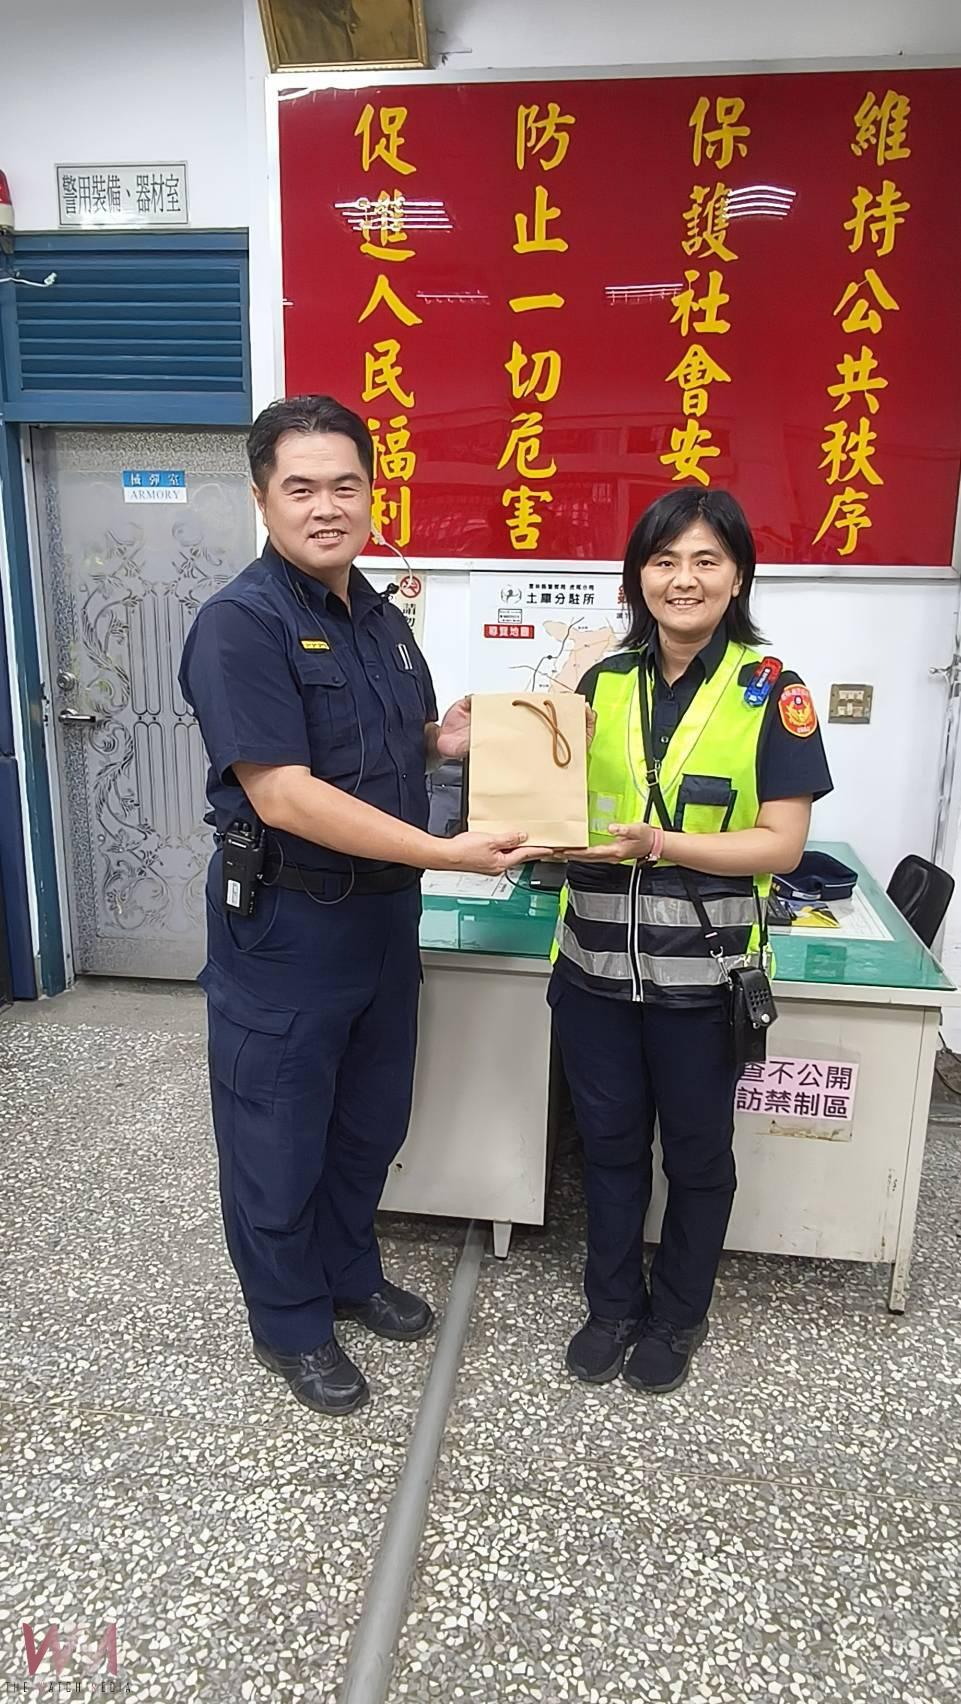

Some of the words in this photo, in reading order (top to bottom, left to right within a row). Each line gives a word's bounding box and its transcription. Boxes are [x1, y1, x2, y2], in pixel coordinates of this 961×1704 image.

[62, 173, 181, 214] 警用裝備、器材室
[354, 103, 423, 548] 促進人民福利
[496, 102, 576, 550] 防止一切危害
[659, 95, 751, 487] 保護社會安
[812, 89, 912, 556] 維持公共秩序
[131, 490, 178, 500] ARMORY
[736, 1086, 850, 1119] 訪禁制區
